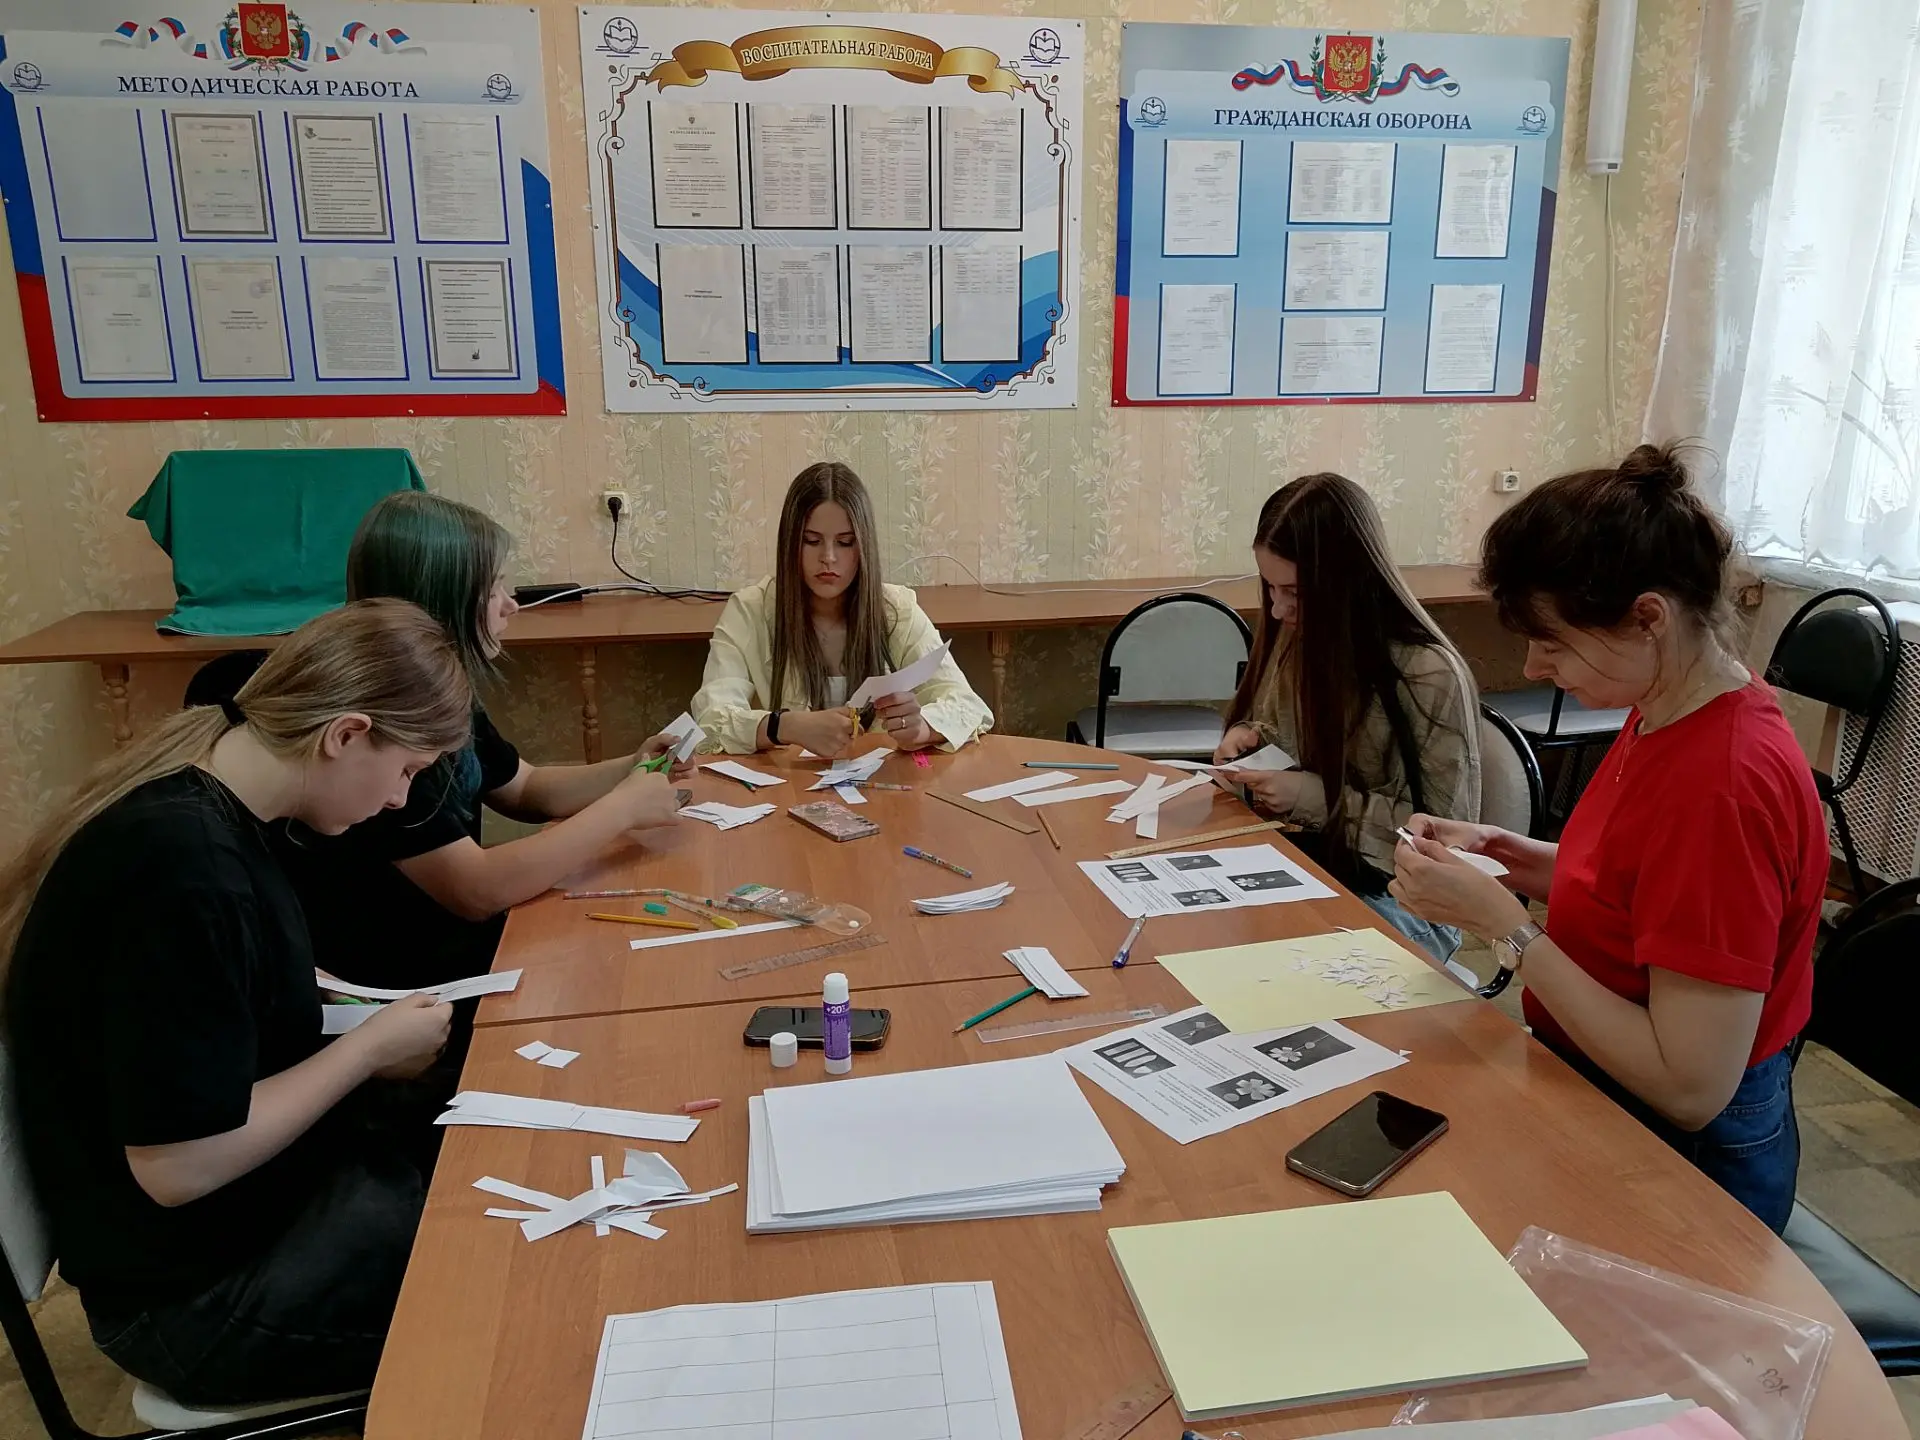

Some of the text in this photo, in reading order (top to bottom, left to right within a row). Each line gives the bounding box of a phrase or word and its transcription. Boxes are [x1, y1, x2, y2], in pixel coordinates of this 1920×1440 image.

[743, 40, 934, 69] ВОСПИТАТЕЛЬНАЯ РАБОТА
[117, 76, 420, 98] МЕТОДИЧЕСКАЯ РАБОТА
[1214, 109, 1473, 130] ГРАЖДАНСКАЯ ОБОРОНА
